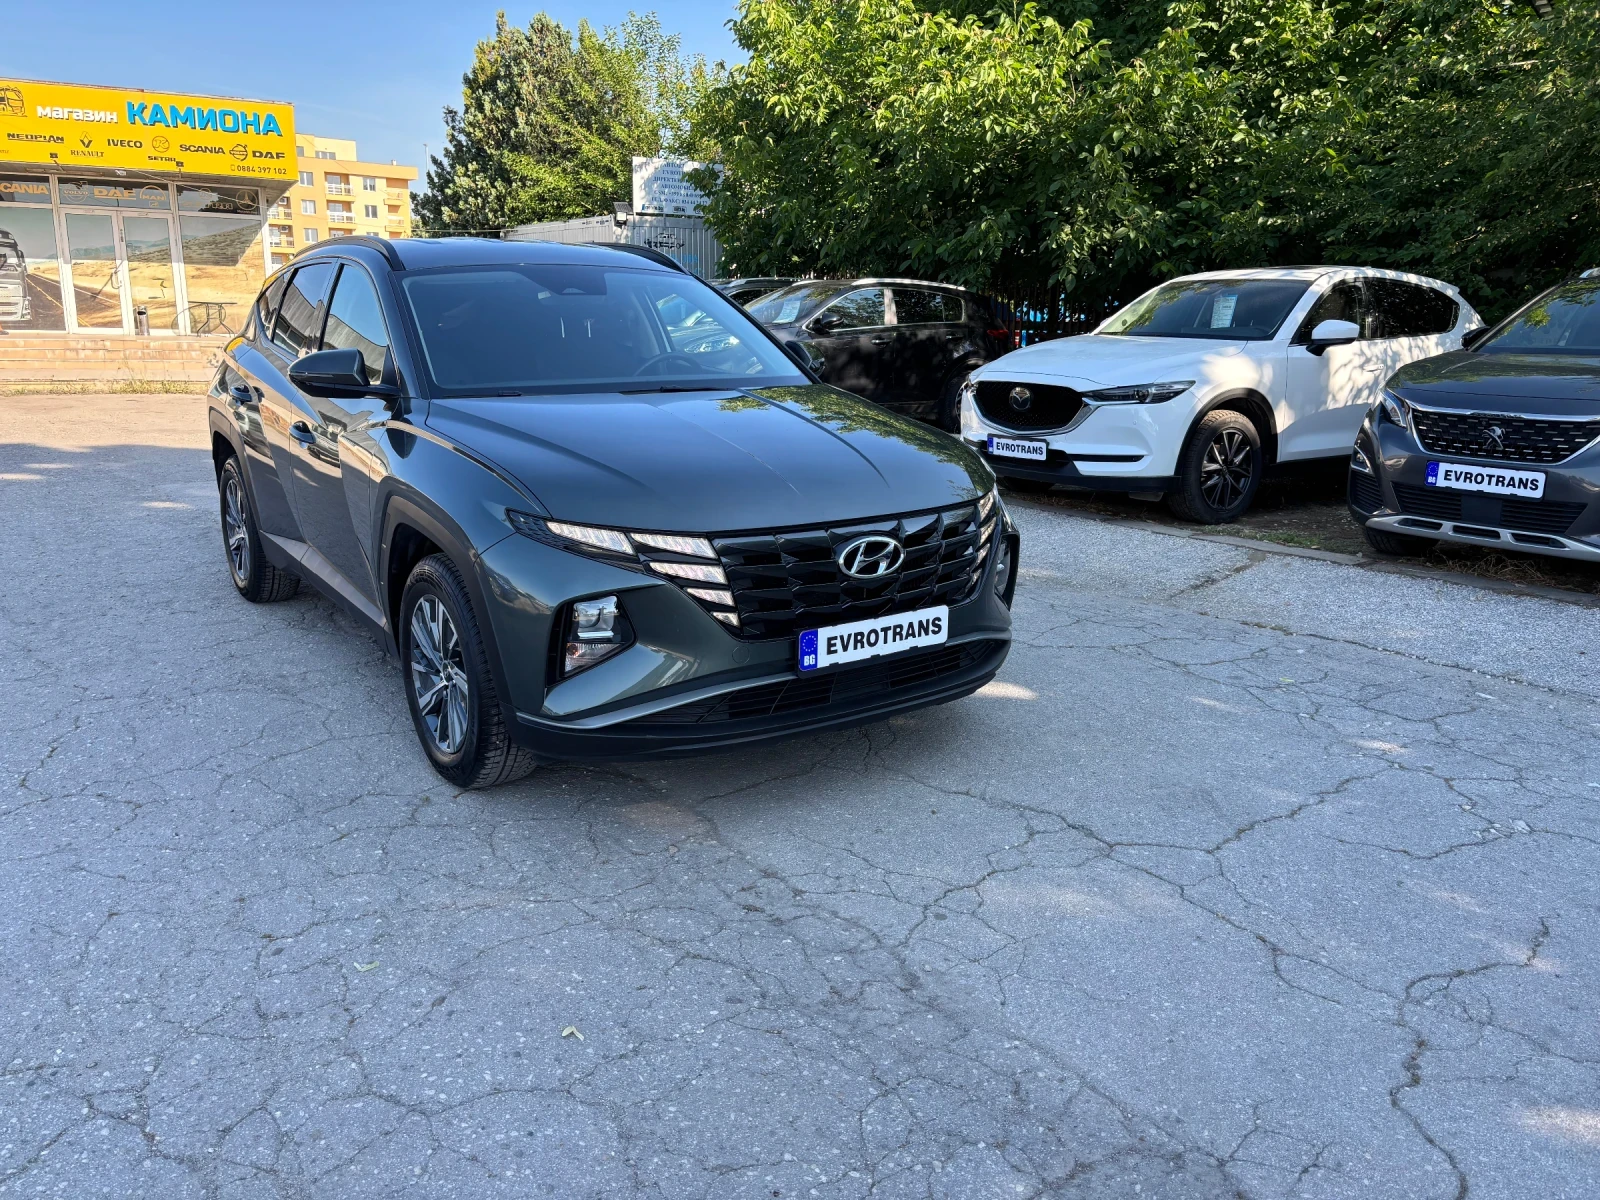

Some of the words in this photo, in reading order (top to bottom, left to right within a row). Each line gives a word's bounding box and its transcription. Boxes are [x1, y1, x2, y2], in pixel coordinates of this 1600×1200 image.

[36, 105, 118, 124] магазин
[126, 101, 283, 137] КАМИОНА
[7, 133, 64, 144] NEOPLAN
[107, 138, 143, 149] IVECO
[70, 149, 105, 158] RENAULT
[179, 144, 226, 155] SCANIA
[252, 150, 286, 160] DAF
[236, 164, 256, 173] 0884
[257, 166, 272, 174] 397
[273, 167, 287, 175] 102
[0, 182, 50, 195] CANIA
[93, 187, 137, 198] DAF
[996, 441, 1044, 456] EVROTRANS
[1443, 469, 1539, 491] EVROTRANS
[803, 654, 816, 667] BG
[826, 616, 942, 656] EVROTRANS
